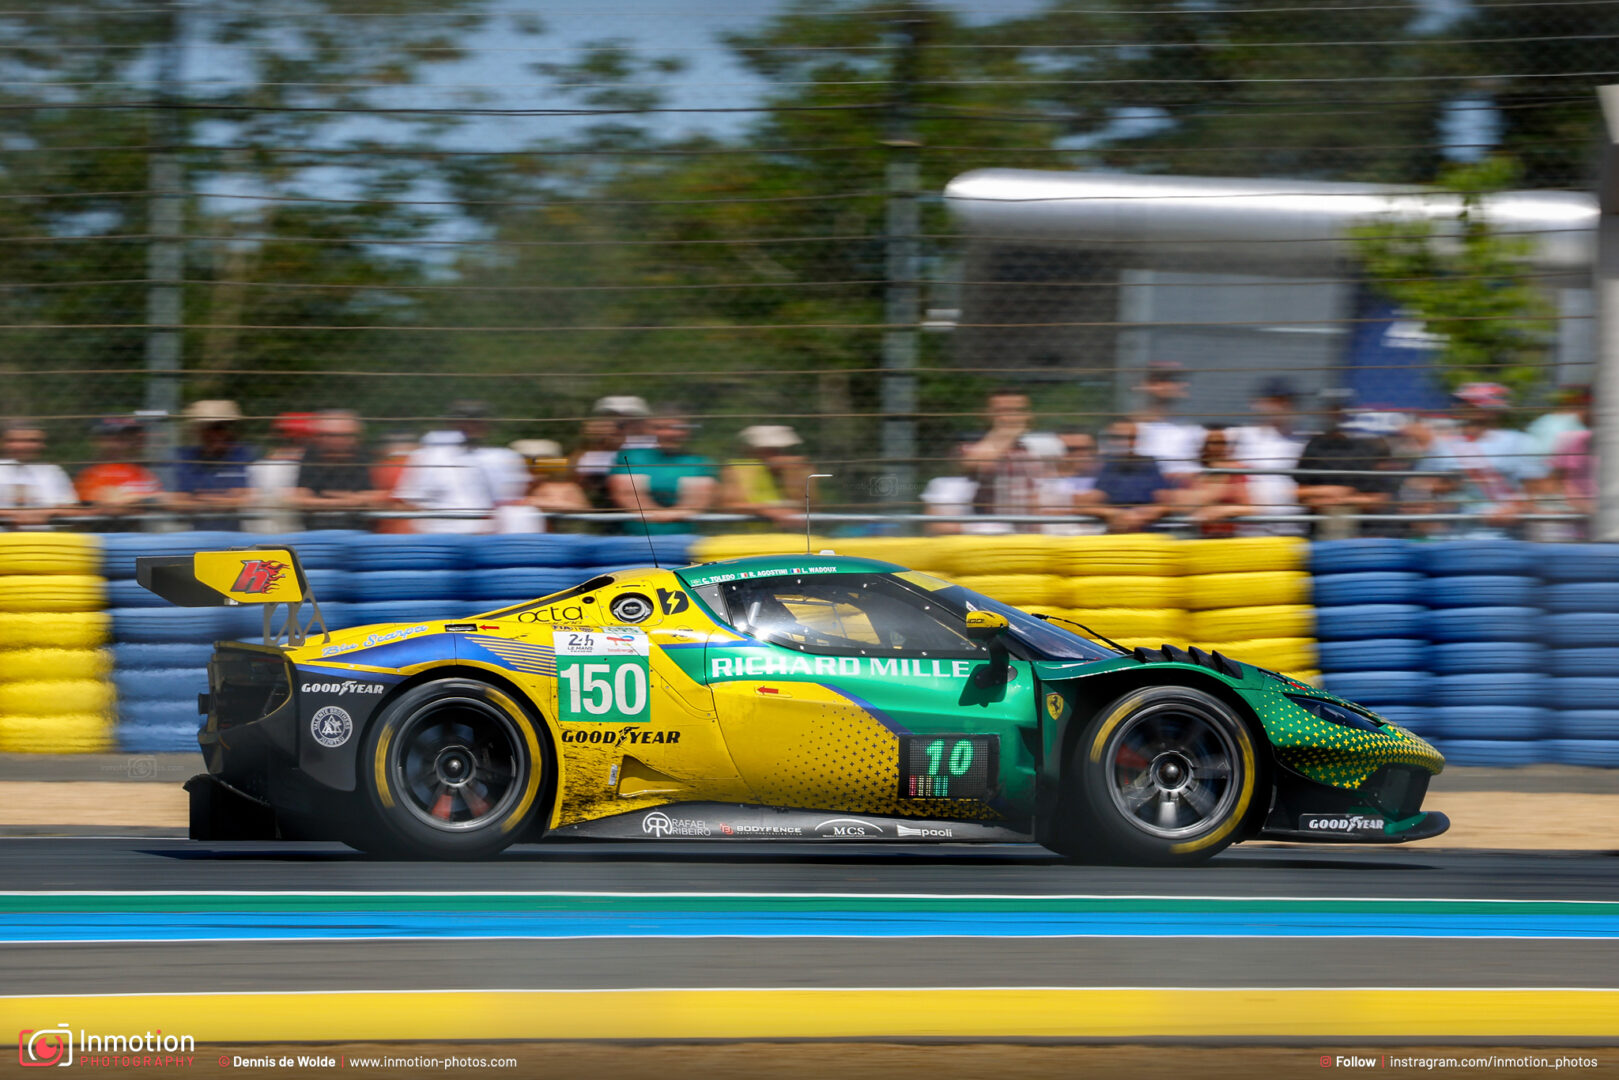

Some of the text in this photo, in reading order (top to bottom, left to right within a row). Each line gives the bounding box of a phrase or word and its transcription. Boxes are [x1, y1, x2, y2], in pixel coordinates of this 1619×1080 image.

[757, 568, 788, 577] AGOSTINI
[808, 566, 837, 574] WADOUX
[701, 573, 736, 585] C. TOLEDO
[363, 624, 430, 648] Scarpa
[711, 656, 972, 678] RICHARD MILLE
[301, 680, 384, 696] GOODYEAR
[560, 663, 647, 715] 150
[561, 727, 681, 747] GOODYEAR
[924, 738, 975, 776] 10
[672, 818, 707, 828] RAFAEL
[737, 825, 802, 833] BODYFENCE
[1309, 816, 1384, 832] GOODYEAR
[672, 827, 711, 837] RIBEIRO
[833, 826, 865, 836] MCS
[921, 828, 952, 838] paoli
